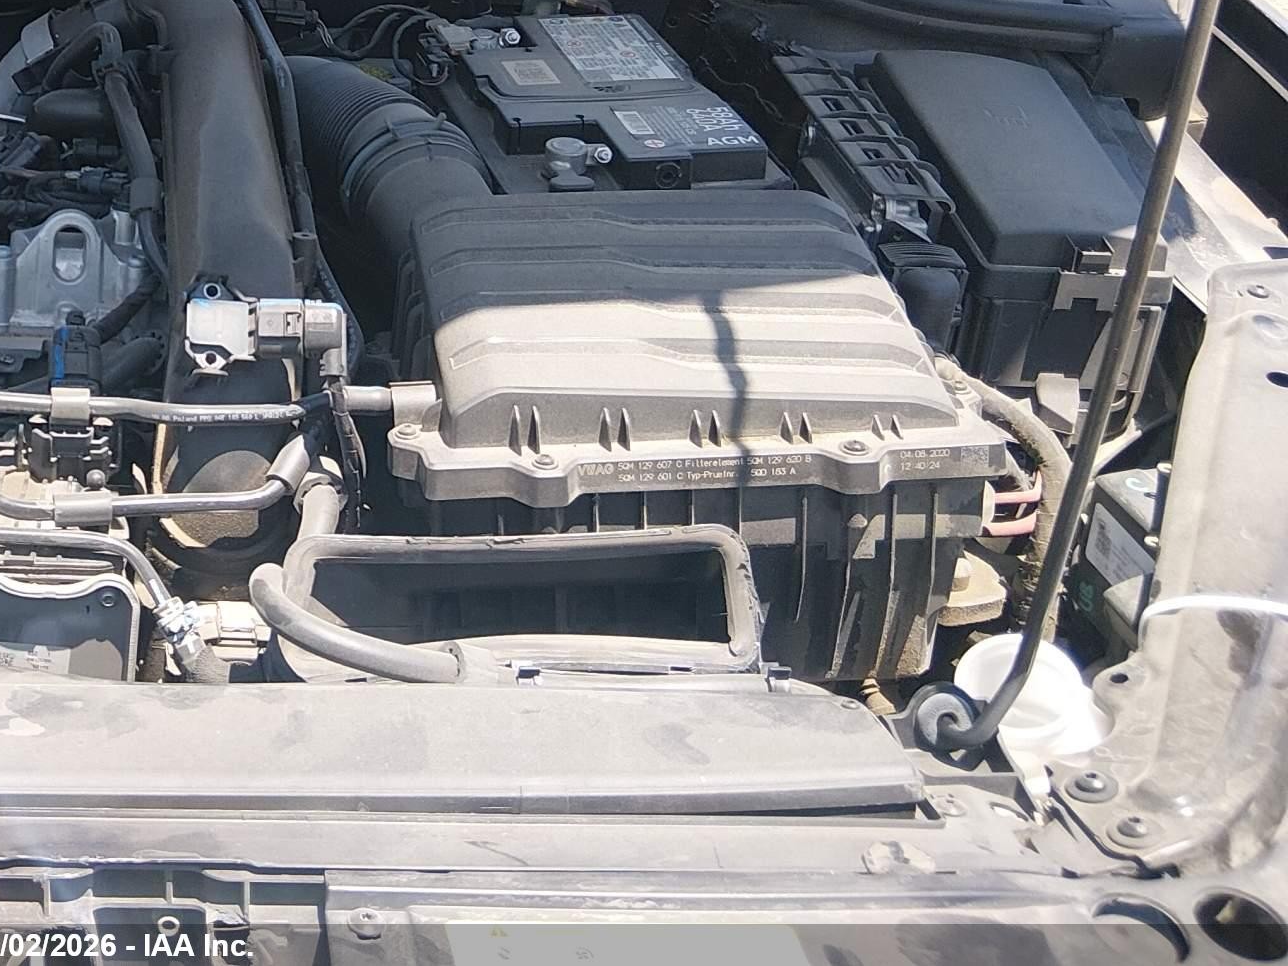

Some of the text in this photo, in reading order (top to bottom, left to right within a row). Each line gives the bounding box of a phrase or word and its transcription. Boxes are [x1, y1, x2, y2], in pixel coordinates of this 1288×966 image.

[706, 106, 744, 131] 58Ah
[707, 134, 760, 146] AGM
[639, 460, 654, 470] 129
[656, 460, 672, 469] 607
[676, 459, 683, 468] C
[639, 473, 654, 482] 129
[657, 472, 672, 481] 601
[676, 472, 684, 480] C
[789, 466, 797, 475] A
